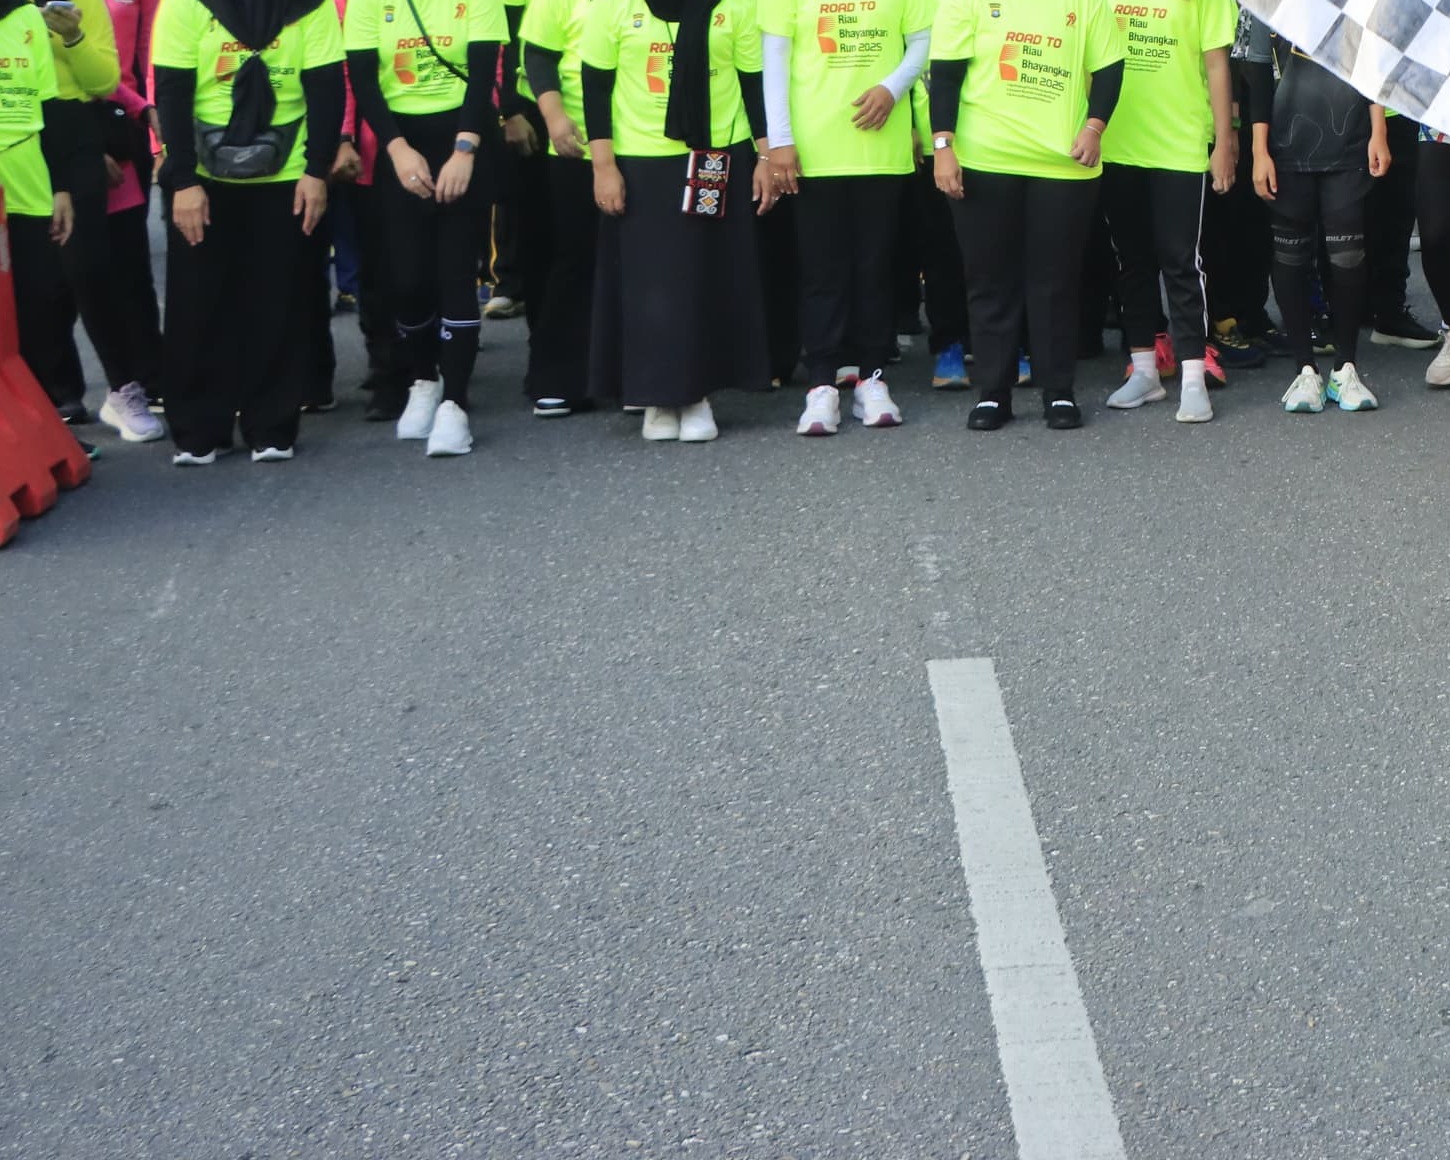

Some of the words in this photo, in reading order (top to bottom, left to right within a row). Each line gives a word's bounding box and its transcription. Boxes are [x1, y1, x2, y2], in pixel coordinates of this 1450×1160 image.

[820, 3, 855, 14] ROAD
[859, 1, 876, 12] TO
[1114, 4, 1148, 17] ROAD
[1152, 7, 1167, 19] TO
[838, 14, 858, 24] Riau
[1129, 18, 1148, 28] Riau
[435, 36, 453, 47] TO
[1005, 32, 1042, 45] ROAD
[1046, 36, 1062, 49] TO
[840, 43, 857, 53] Run
[858, 42, 882, 52] 2025
[1022, 45, 1042, 56] Riau
[1145, 48, 1170, 59] 2025
[14, 57, 29, 68] TO
[1020, 73, 1037, 85] Run
[1039, 77, 1065, 91] 2025
